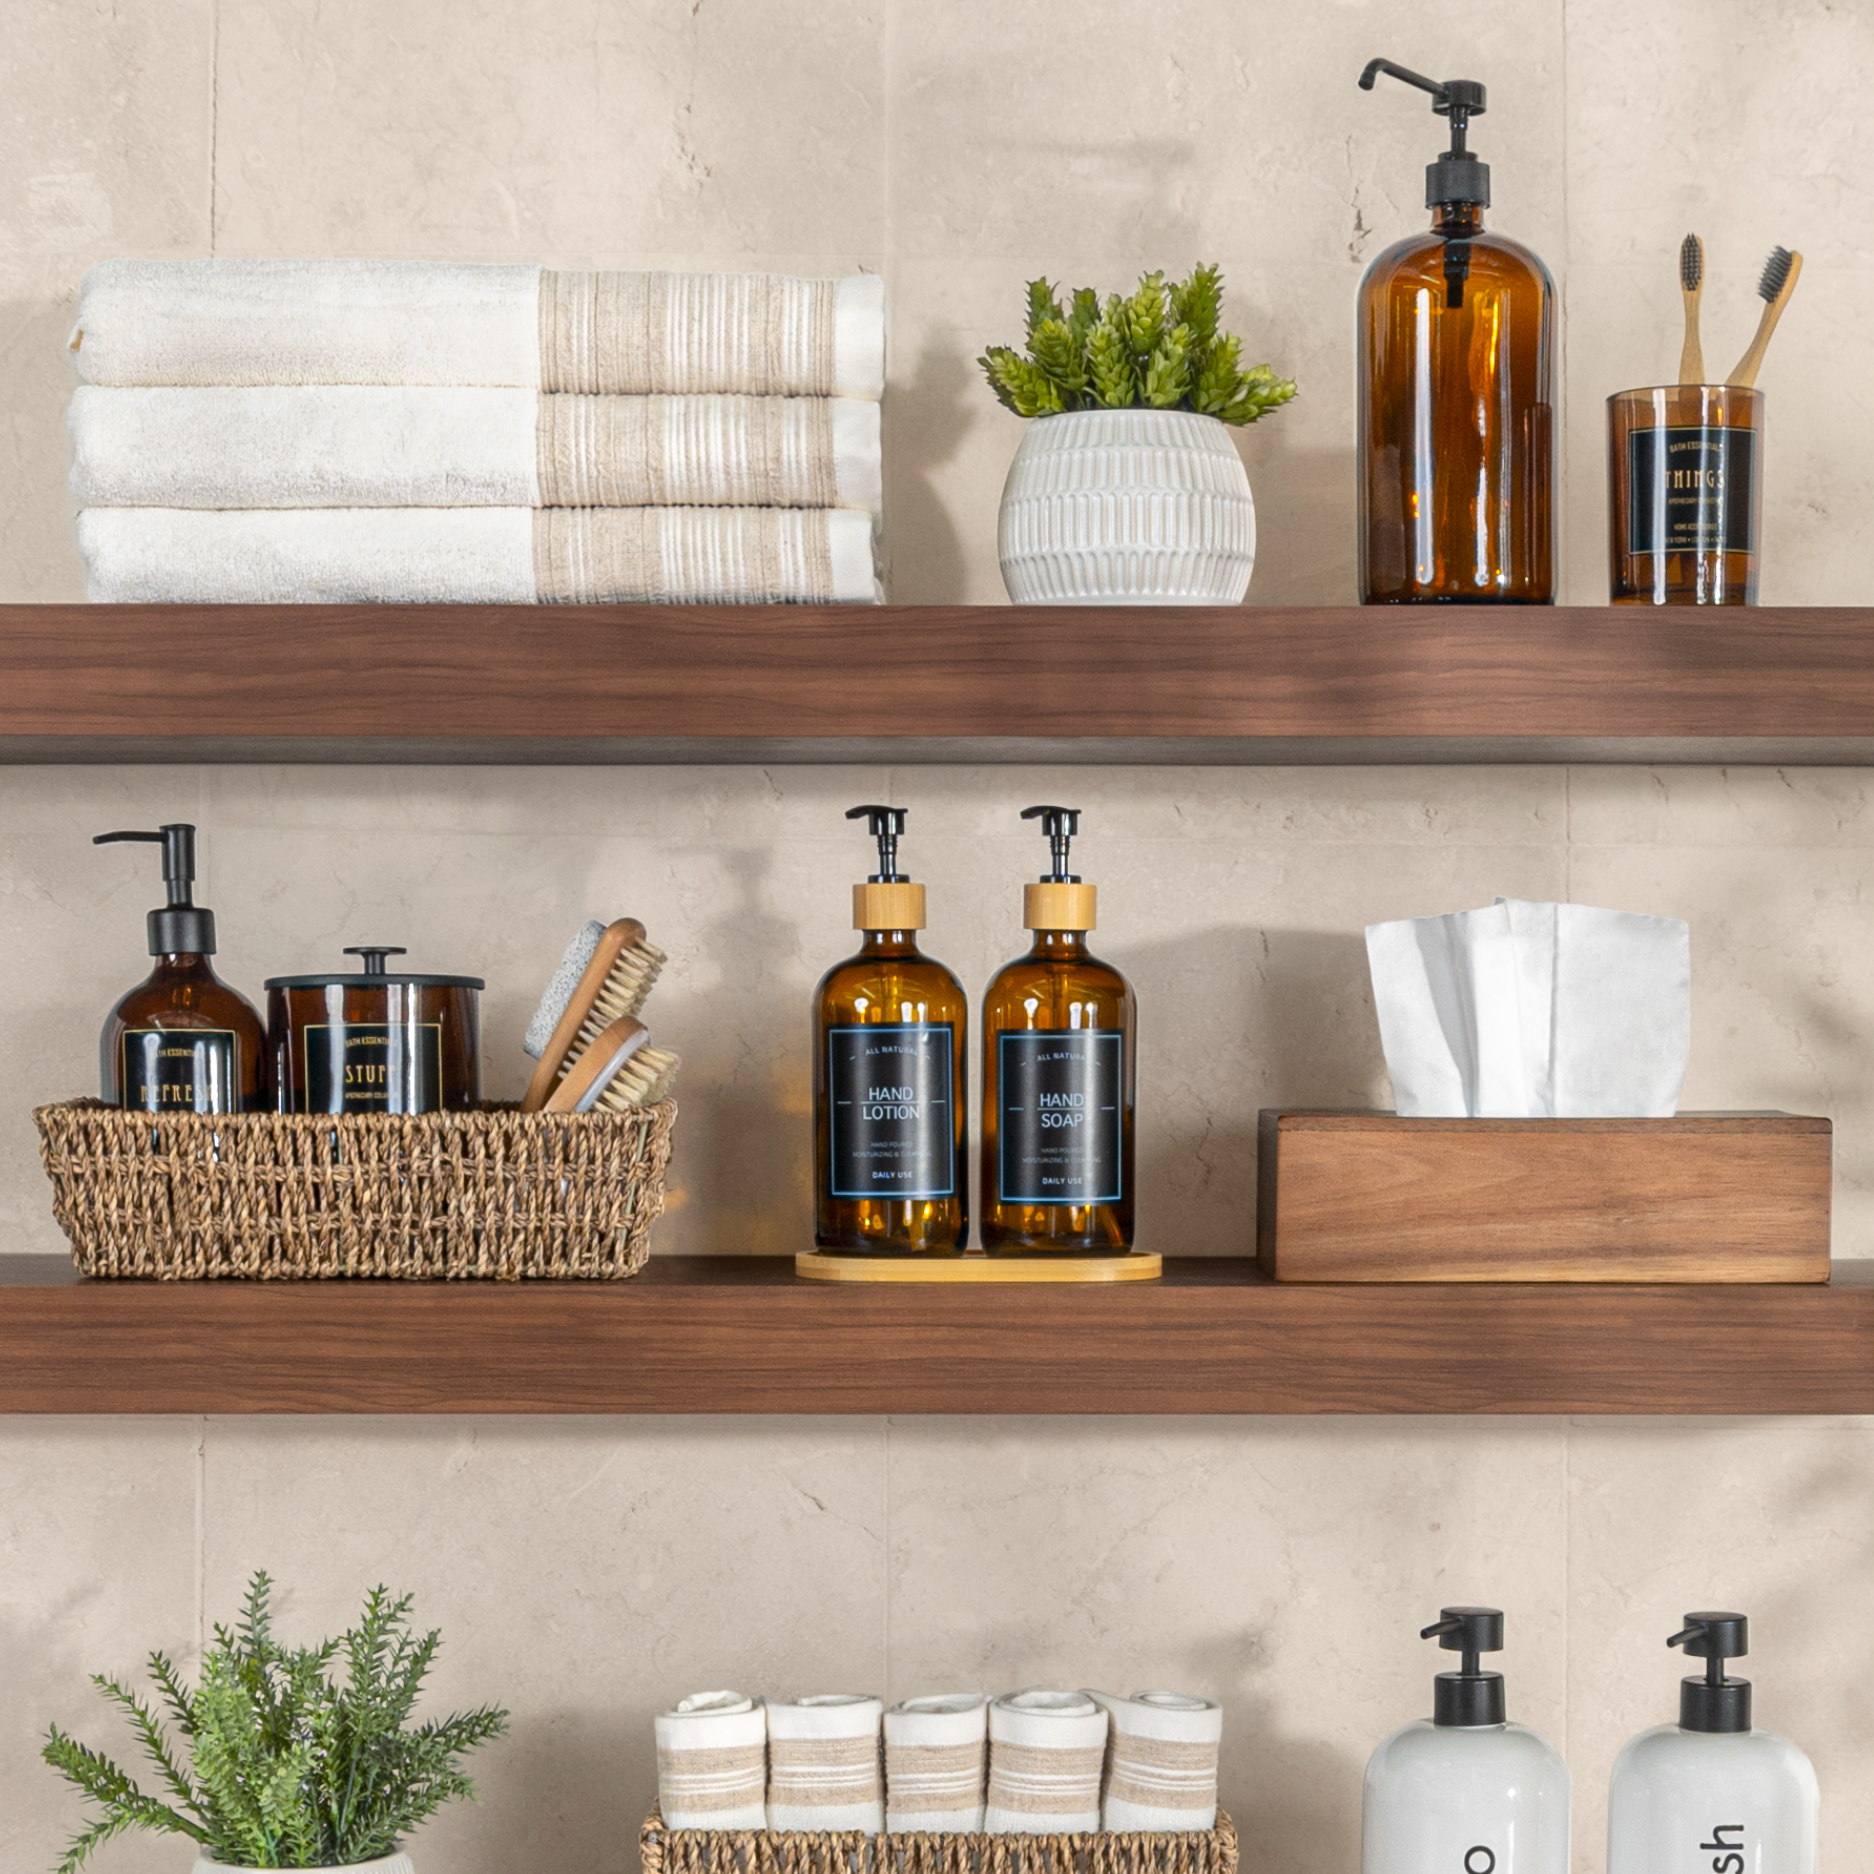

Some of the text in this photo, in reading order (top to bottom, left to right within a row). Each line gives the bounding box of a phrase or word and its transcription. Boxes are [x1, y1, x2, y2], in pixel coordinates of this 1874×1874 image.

[1687, 440, 1723, 453] ESSETIAL
[1665, 469, 1725, 489] THINGS
[1687, 522, 1717, 531] ACCESORIES
[865, 1045, 918, 1056] ALL NATURAL
[1037, 1051, 1087, 1062] ALL NATURA
[345, 1064, 396, 1083] STUFF
[868, 1086, 914, 1100] HAND
[1040, 1093, 1085, 1107] HAND
[862, 1105, 920, 1120] LOTION
[1041, 1113, 1084, 1128] SOAP
[872, 1171, 914, 1179] DAILY USE
[1041, 1177, 1083, 1185] DAILY USE
